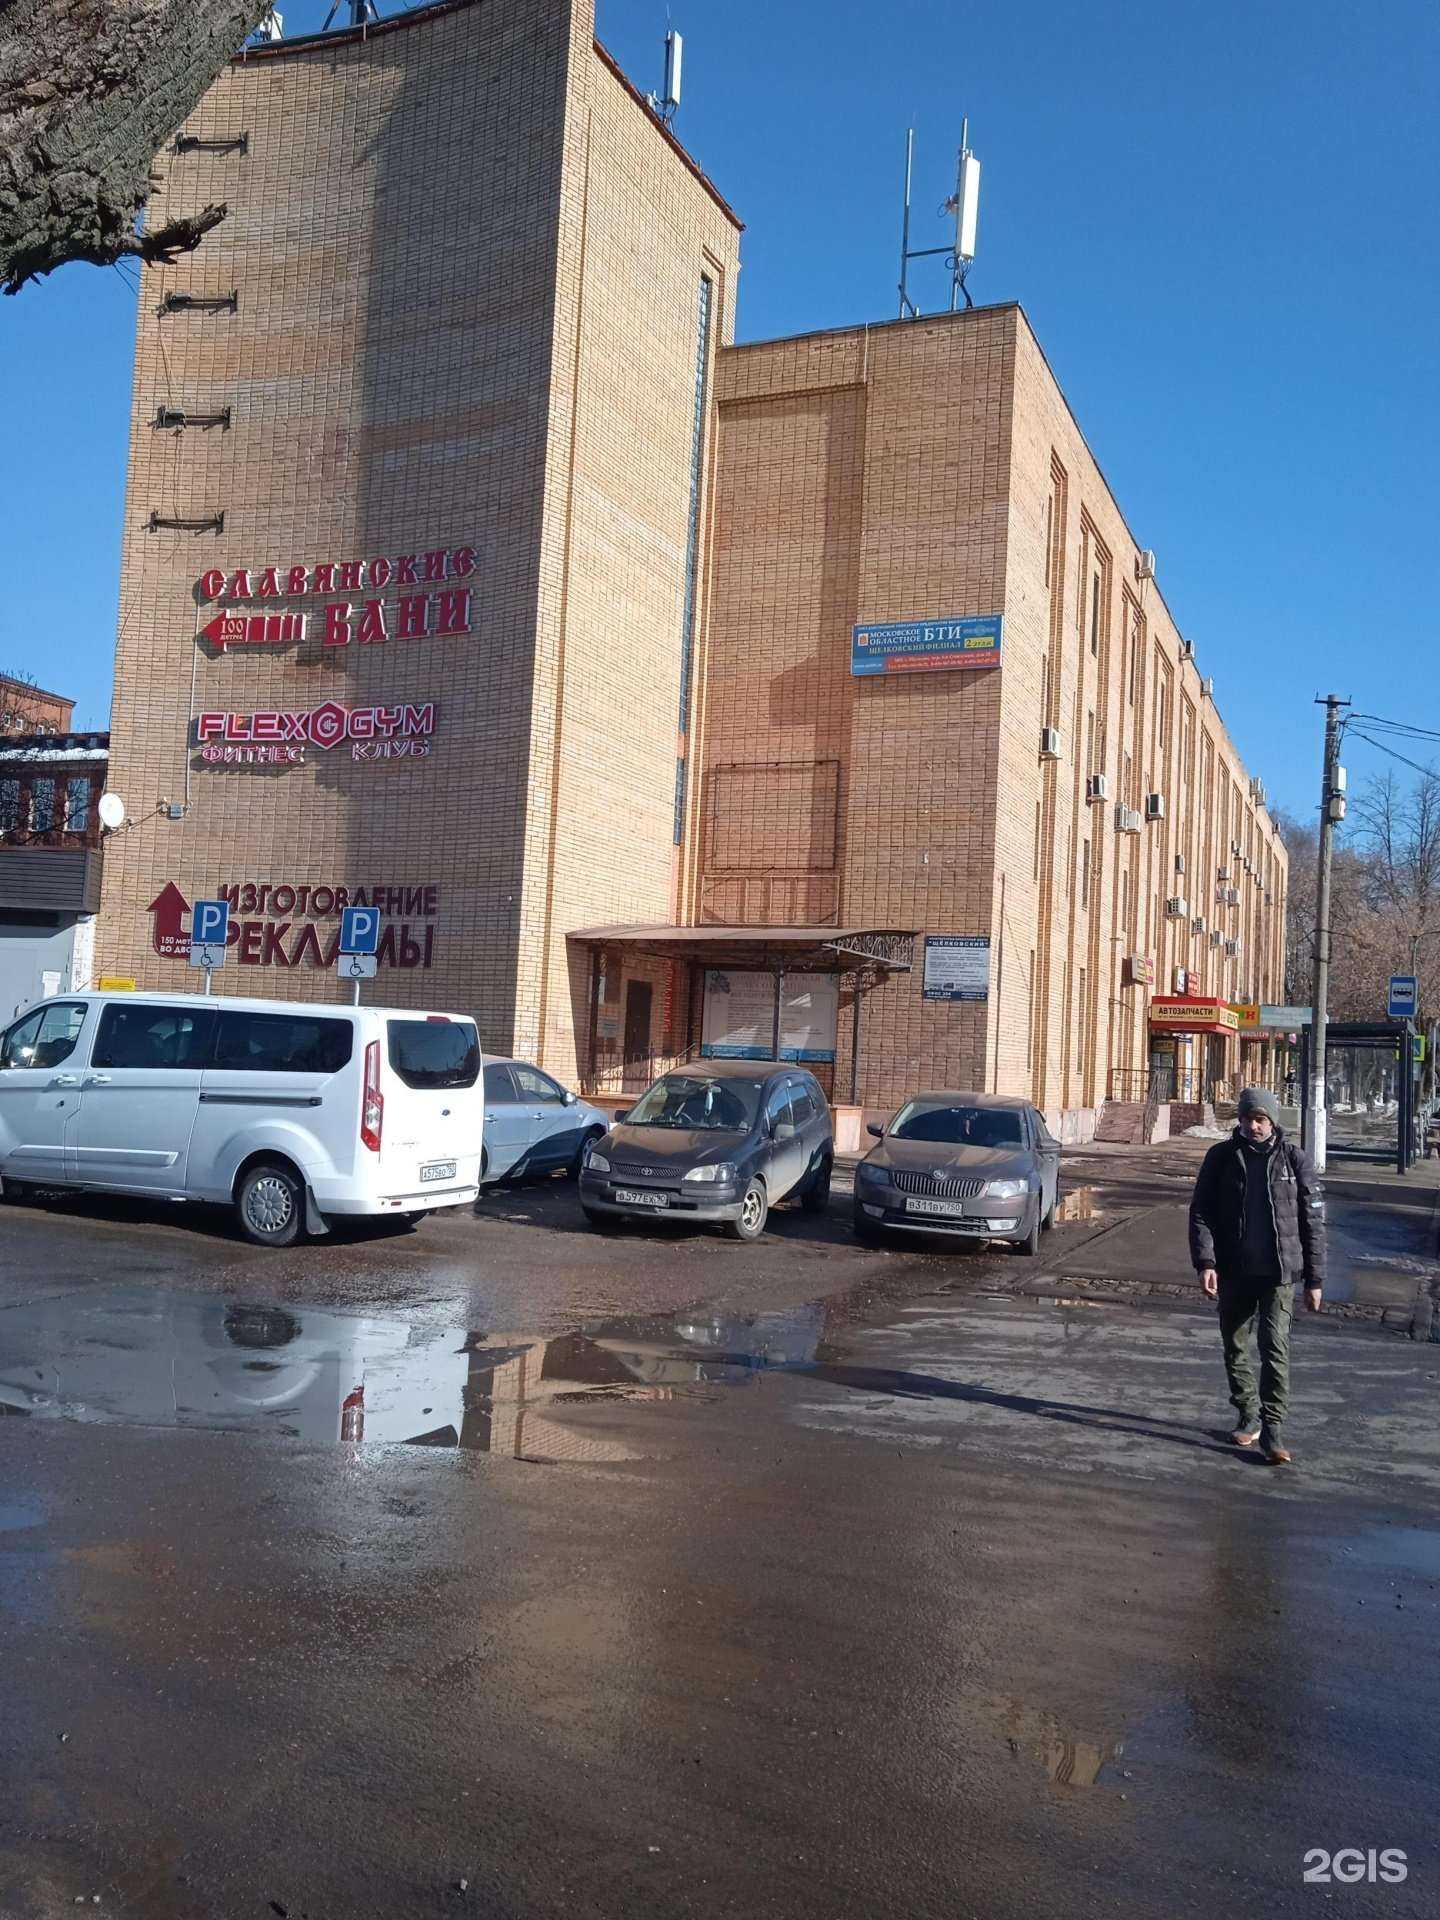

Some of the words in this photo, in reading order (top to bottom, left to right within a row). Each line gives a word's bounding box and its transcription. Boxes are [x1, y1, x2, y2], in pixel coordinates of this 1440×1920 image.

[202, 547, 477, 599] СЛАВЯНСКИЕ
[220, 619, 244, 634] 100
[324, 588, 473, 647] БАНИ
[924, 626, 961, 641] БТИ
[197, 712, 309, 741] FLEX
[349, 703, 435, 737] GYM
[201, 745, 304, 763] ФИТНЕС
[351, 739, 430, 762] КЛУБ
[222, 883, 437, 916] ИЗГОТОВЛЕНИЕ
[201, 905, 221, 939] P
[350, 912, 372, 947] P
[1158, 1006, 1213, 1016] АВТОЗАПЧАСТИ
